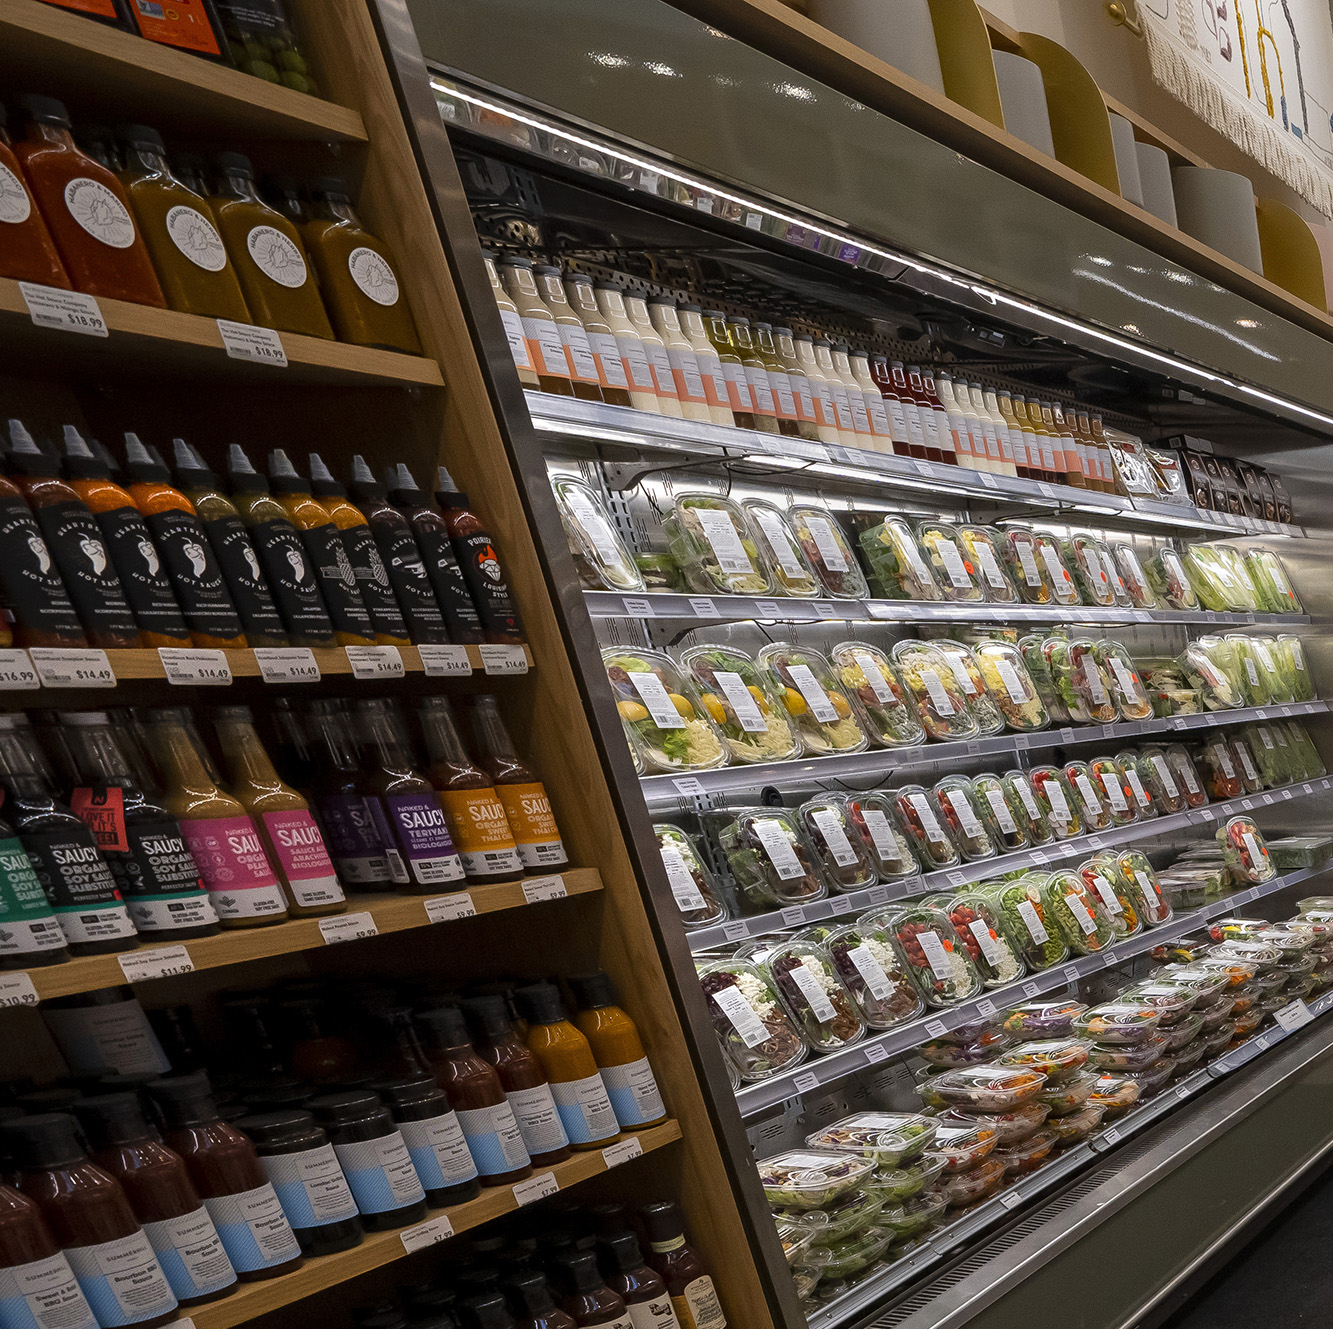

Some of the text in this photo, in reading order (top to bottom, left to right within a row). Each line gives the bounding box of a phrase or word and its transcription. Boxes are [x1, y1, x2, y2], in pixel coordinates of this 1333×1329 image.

[68, 313, 102, 329] $18.99
[255, 347, 283, 358] $18.99
[377, 662, 402, 672] $14.49
[447, 661, 469, 670] $14.49
[505, 660, 526, 669] $14.49
[76, 669, 111, 681] $14.49
[198, 668, 228, 679] $14.49
[290, 666, 318, 677] $14.49
[401, 809, 446, 829] SAUCY
[142, 838, 184, 856] SAUCY
[54, 846, 99, 864] SAUCY
[356, 928, 377, 939] $9.99
[161, 964, 192, 976] $11.99
